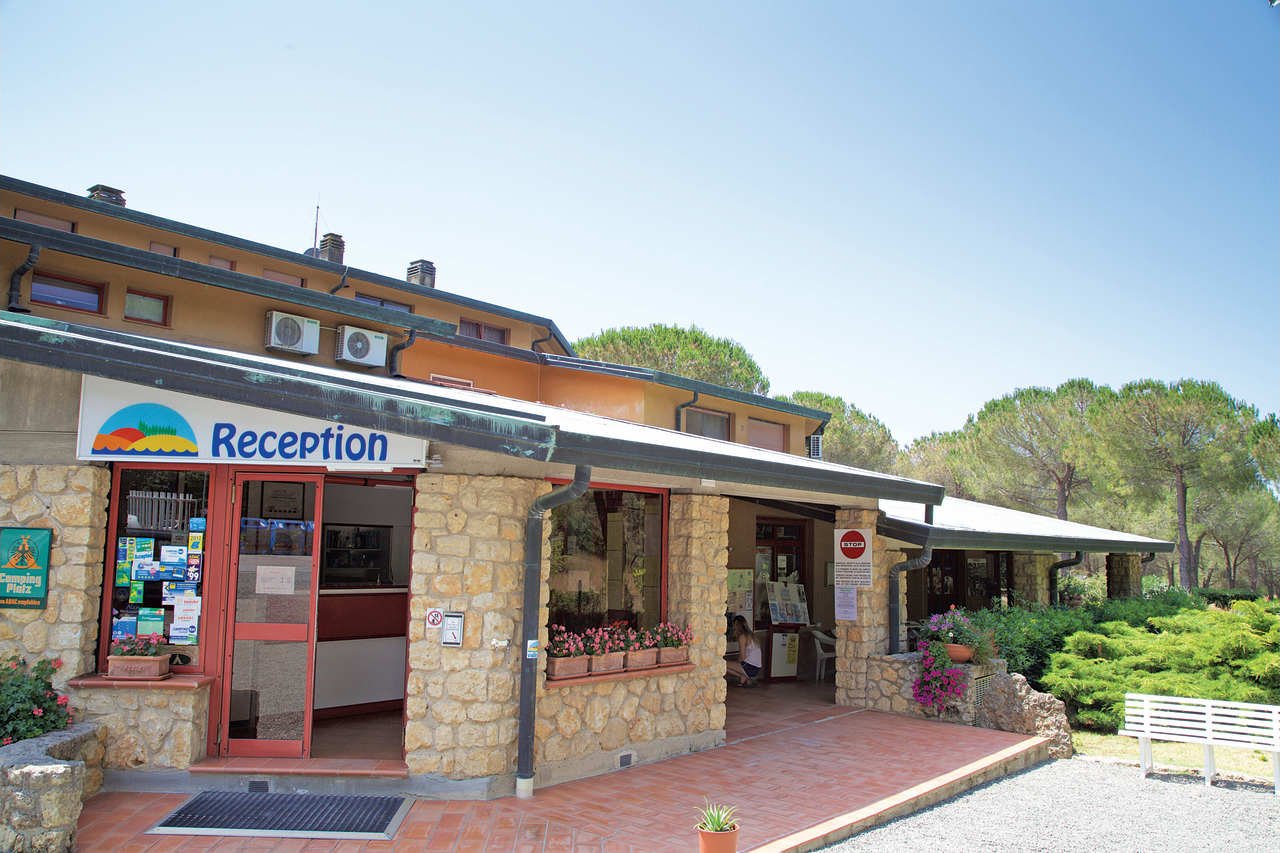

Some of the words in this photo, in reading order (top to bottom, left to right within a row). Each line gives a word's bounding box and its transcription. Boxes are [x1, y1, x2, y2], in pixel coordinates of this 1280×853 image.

[211, 422, 388, 461] Reception
[0, 572, 42, 587] Camping
[6, 583, 32, 594] Platz
